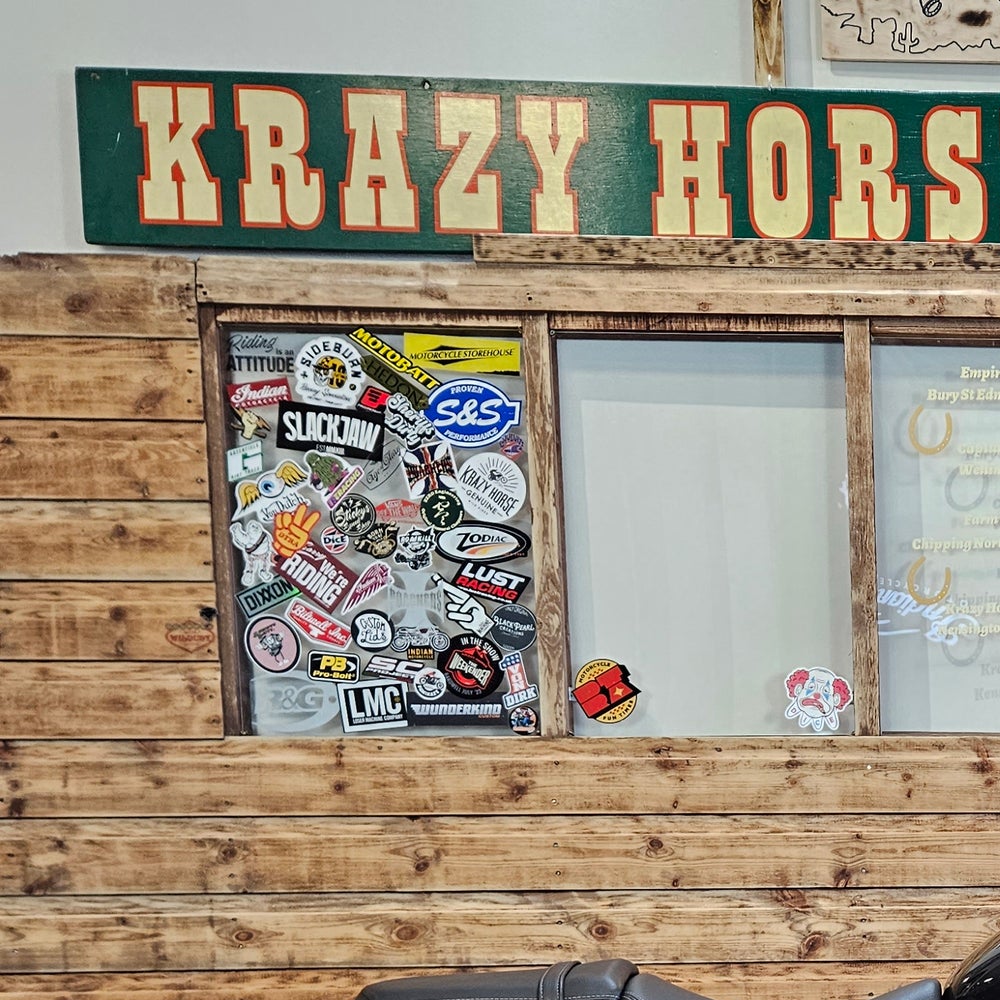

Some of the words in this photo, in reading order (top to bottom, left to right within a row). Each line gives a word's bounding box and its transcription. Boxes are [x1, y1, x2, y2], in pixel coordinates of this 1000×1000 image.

[132, 81, 588, 234] KRAZY
[230, 334, 278, 353] Riding
[410, 351, 461, 360] MOTORCYCLE
[463, 348, 515, 358] STOREHOUSE
[227, 355, 295, 373] ATTITUDE
[301, 341, 361, 379] SIDEBURN
[352, 327, 441, 389] MOTOBATT
[366, 360, 423, 406] HEDON
[450, 385, 484, 394] PROVEN
[231, 384, 288, 404] Indian
[927, 388, 960, 404] Bury
[960, 388, 975, 401] St
[433, 398, 501, 427] S&S
[282, 411, 381, 453] SLACKJAW
[444, 427, 499, 442] PERFORMANCE
[460, 465, 492, 494] KRAZY
[488, 487, 520, 517] HORSE
[466, 489, 498, 515] GENUINE
[456, 532, 507, 552] ZODIAC
[912, 536, 972, 552] Chipping
[281, 552, 340, 606] RIDING
[461, 562, 525, 590] LUST
[244, 577, 294, 611] DIXXON
[456, 577, 518, 600] RACING
[945, 602, 983, 618] Krazy
[359, 617, 386, 629] CUSTOM
[461, 637, 469, 646] IN
[470, 637, 482, 647] THE
[482, 641, 500, 662] SHOW
[320, 656, 348, 672] PB
[368, 656, 424, 674] SC
[449, 652, 491, 686] WEEKENDER
[578, 661, 611, 683] MOTORCYCLE
[312, 670, 352, 680] Pro-Bolt
[348, 686, 402, 718] LMC
[506, 687, 537, 707] DIRK
[410, 704, 502, 715] WUNDERKIND
